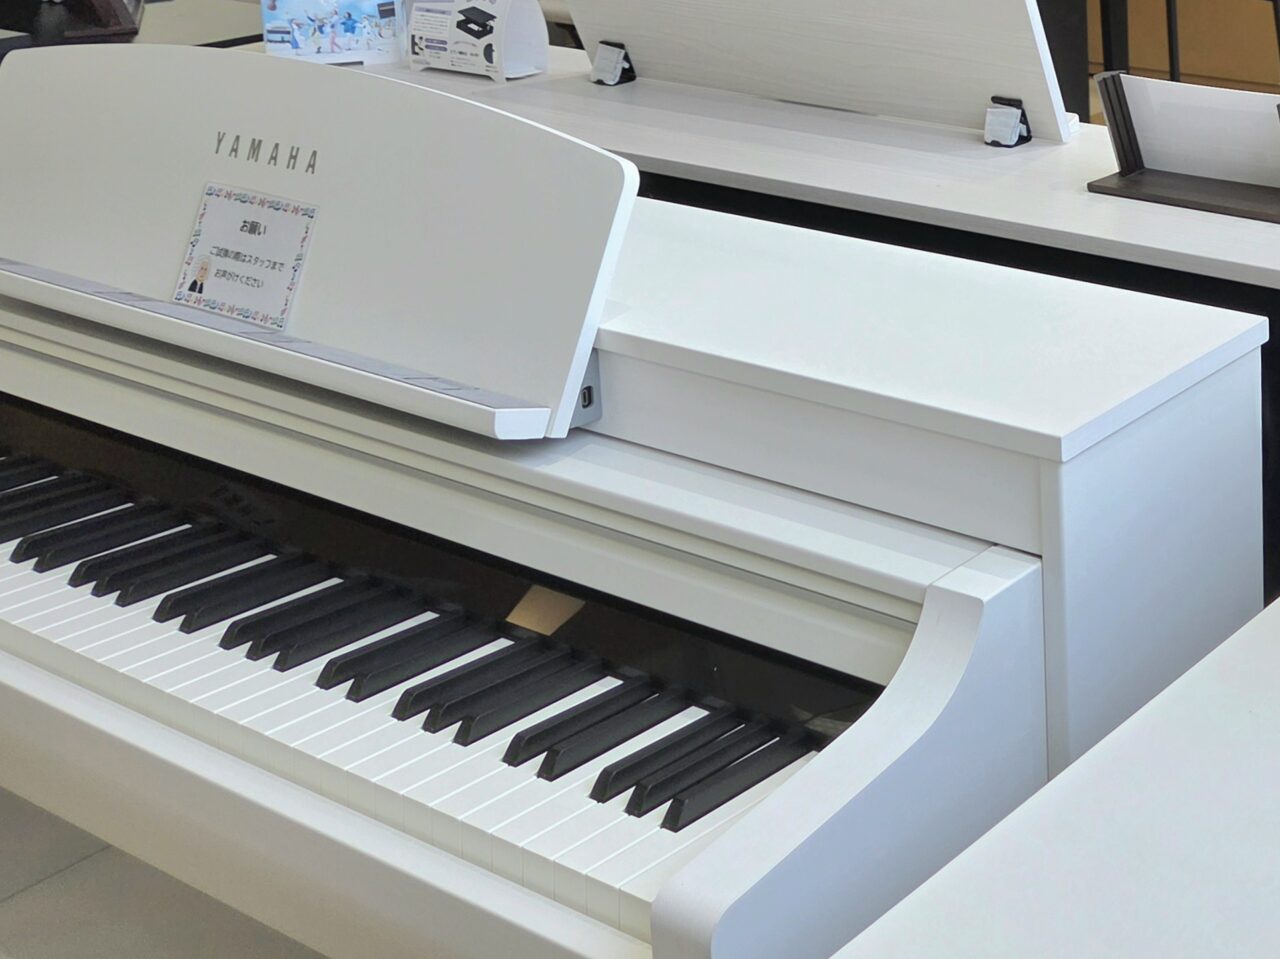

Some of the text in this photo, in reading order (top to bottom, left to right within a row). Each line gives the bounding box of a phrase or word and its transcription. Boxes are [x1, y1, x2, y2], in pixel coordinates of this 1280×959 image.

[215, 131, 318, 174] YAMAHA
[239, 220, 267, 236] お願い
